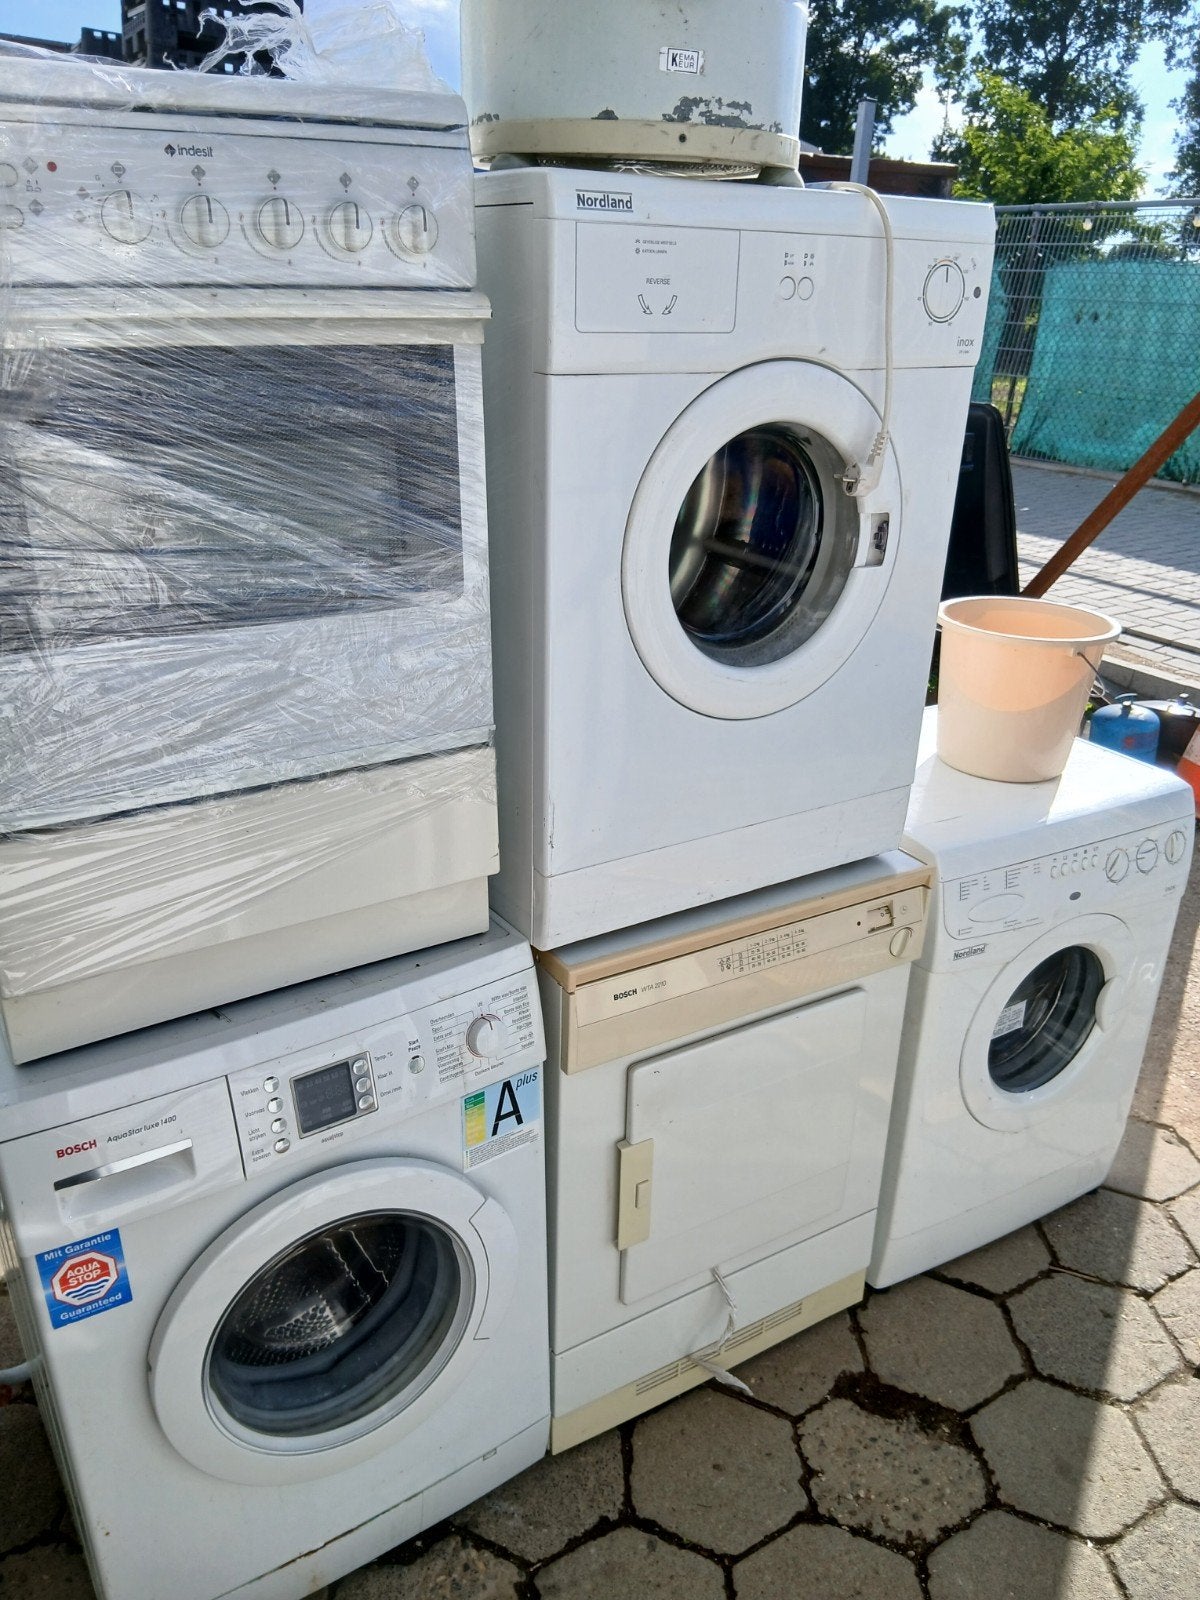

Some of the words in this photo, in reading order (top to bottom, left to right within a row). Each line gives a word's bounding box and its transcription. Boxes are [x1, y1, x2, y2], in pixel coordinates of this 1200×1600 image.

[177, 144, 214, 158] indesit
[576, 193, 633, 210] Nordland
[645, 277, 671, 286] REVERSE
[956, 336, 975, 347] inox
[953, 944, 986, 960] Nordland
[613, 988, 638, 1001] BOSCH
[516, 1071, 538, 1091] plus
[491, 1079, 524, 1137] A
[56, 1139, 98, 1159] BOSCH
[106, 1126, 143, 1144] AquaStar
[143, 1120, 160, 1132] luxe
[160, 1114, 177, 1127] 1400
[44, 1250, 62, 1261] Mit
[65, 1234, 111, 1254] Garantie
[67, 1260, 101, 1279] AQUA
[68, 1269, 102, 1287] STOP
[60, 1292, 122, 1320] Guaranteed
